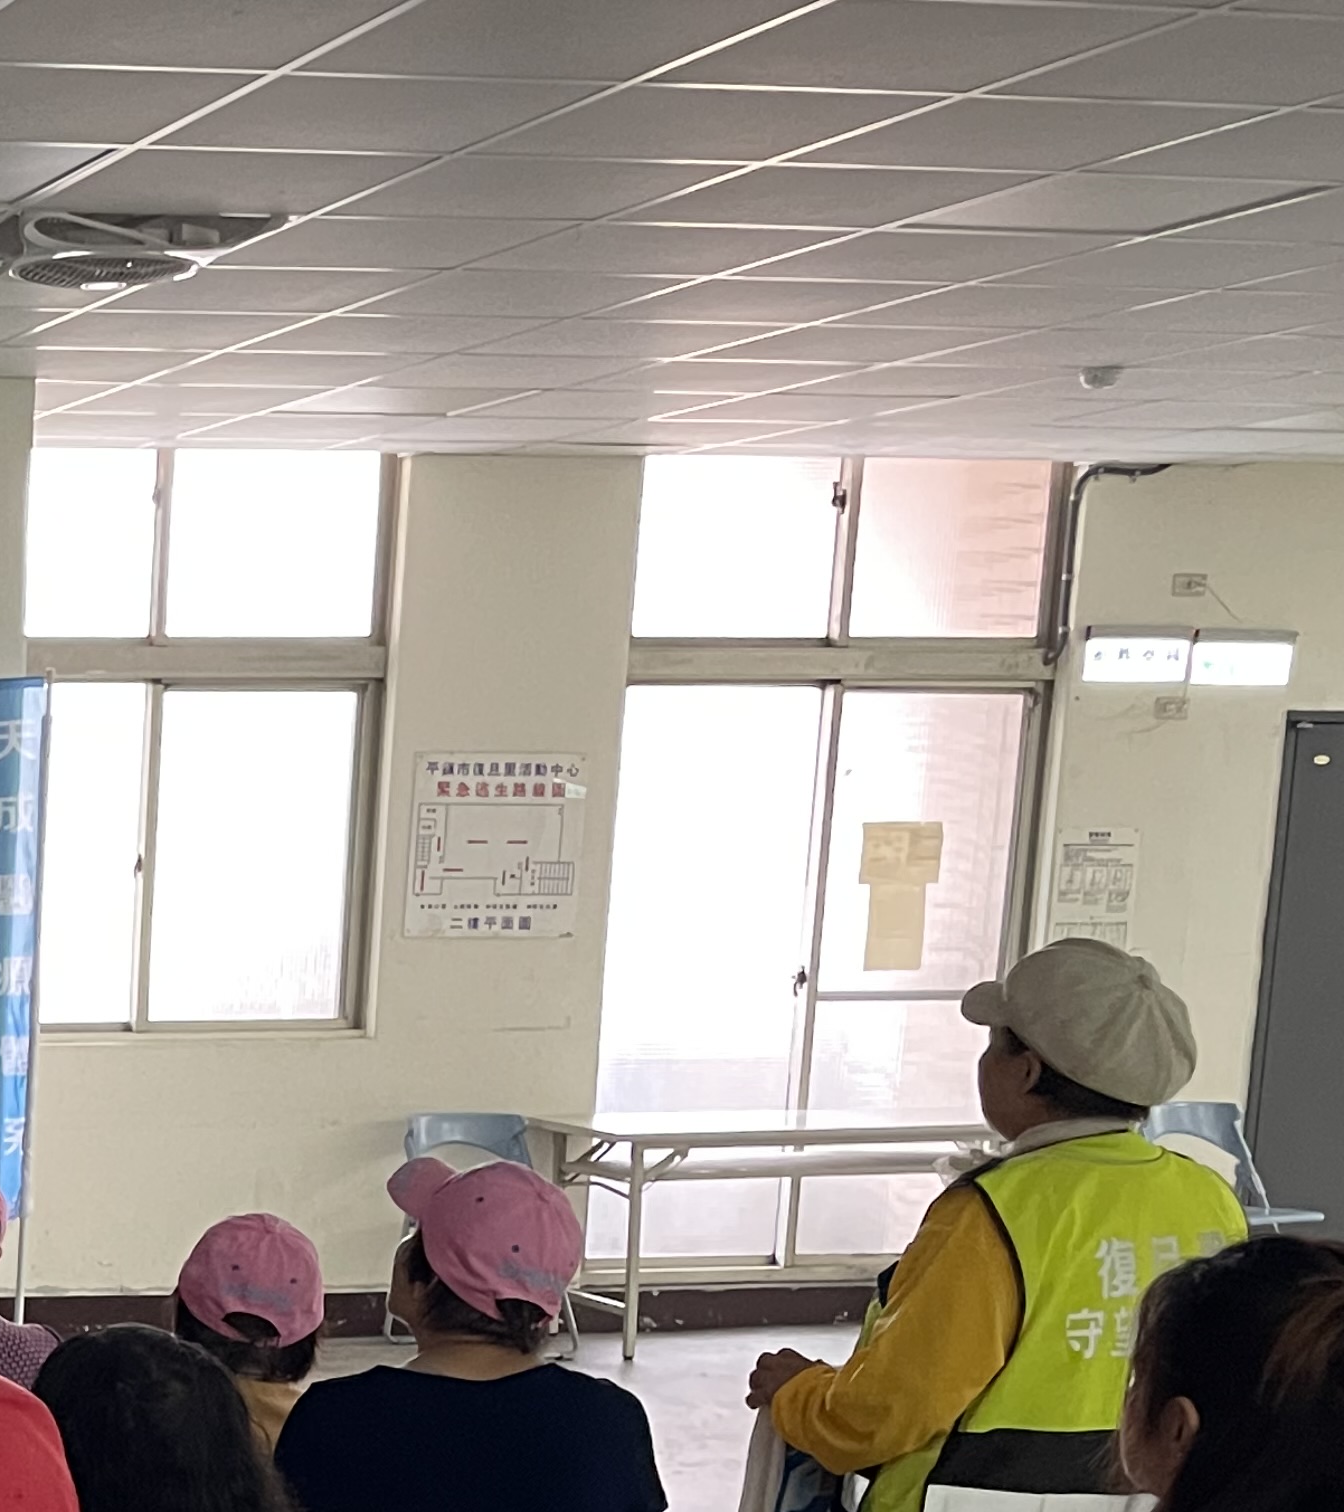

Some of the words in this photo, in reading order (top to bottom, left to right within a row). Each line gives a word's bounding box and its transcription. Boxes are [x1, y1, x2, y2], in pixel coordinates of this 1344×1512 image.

[425, 761, 580, 777] 平鎮市復旦里活動中心
[436, 781, 566, 798] 緊急逃生路線圖
[449, 915, 532, 931] 二樓平面圖
